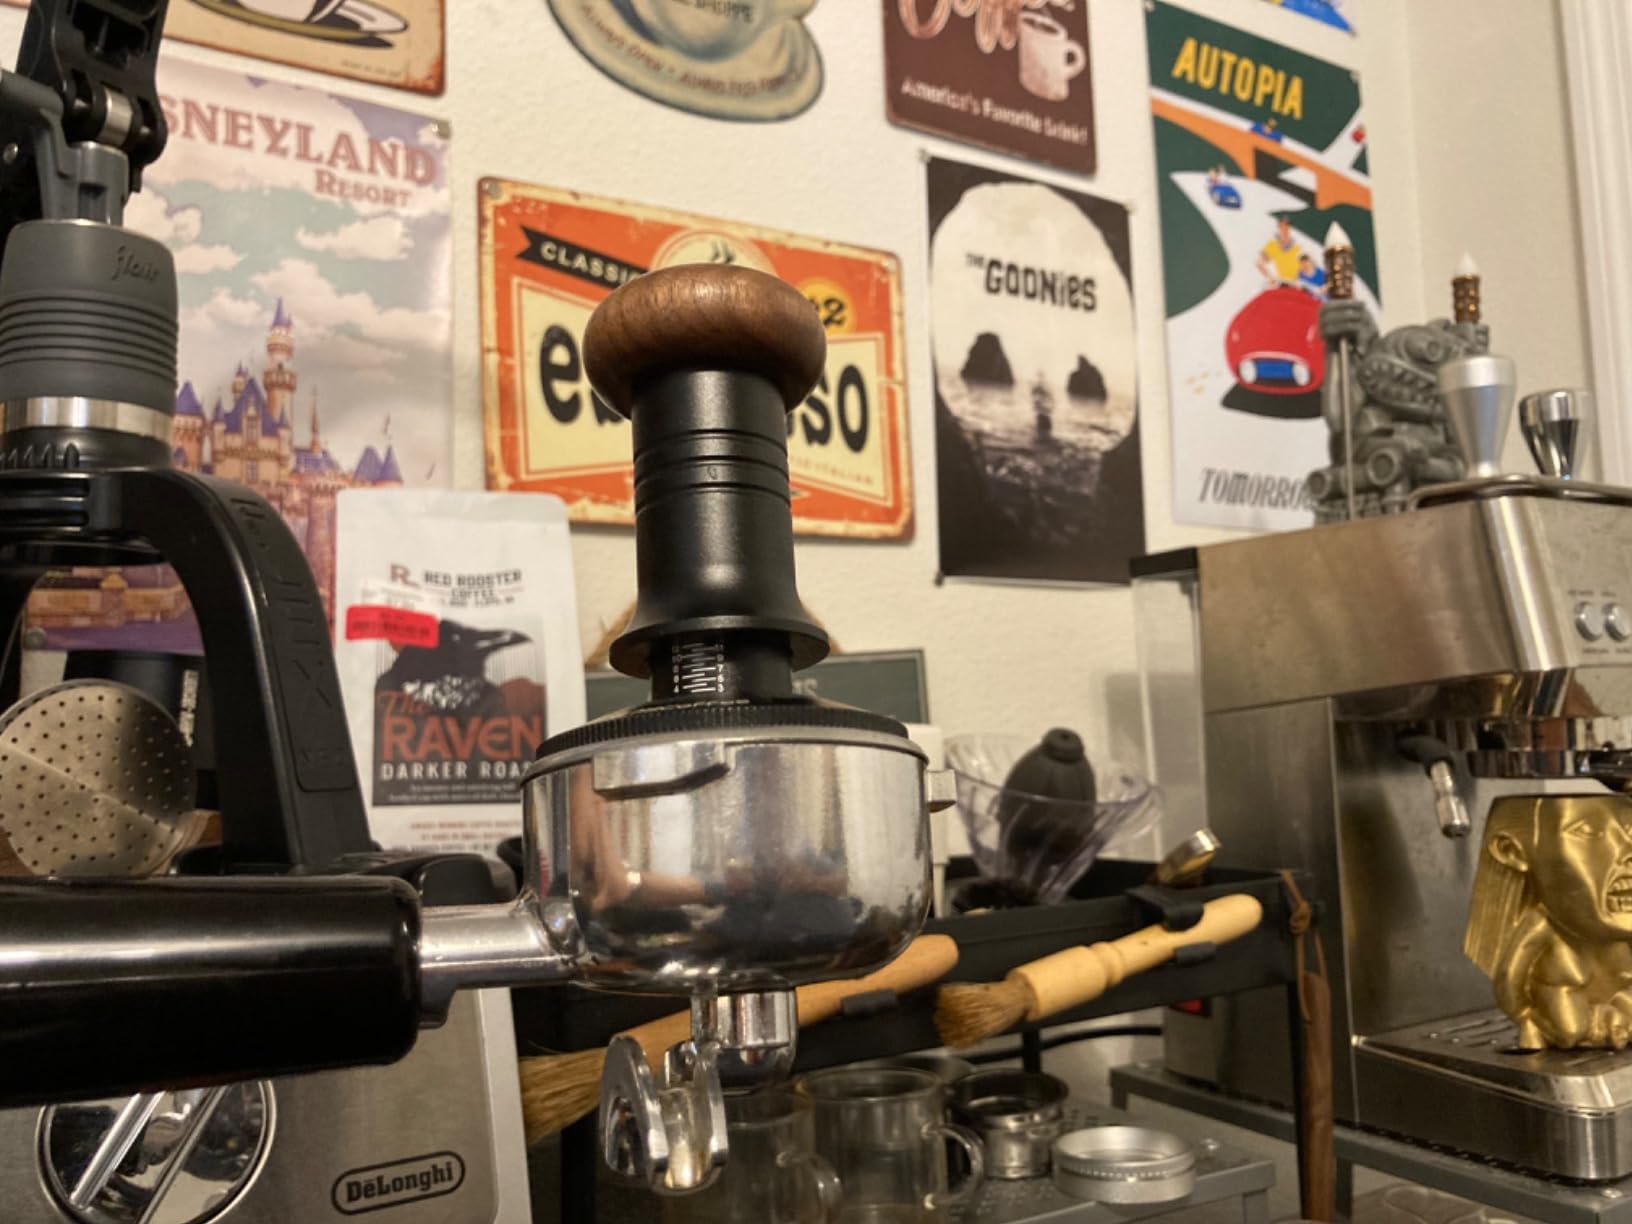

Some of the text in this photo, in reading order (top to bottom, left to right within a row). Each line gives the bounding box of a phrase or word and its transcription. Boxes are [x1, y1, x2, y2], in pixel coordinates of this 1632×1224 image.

[901, 76, 981, 116] America's
[1171, 36, 1304, 121] AUTOPIA
[158, 94, 438, 185] SNEYLAND
[424, 570, 453, 588] RED
[457, 568, 523, 588] ROOSTER
[382, 714, 543, 762] RAVEN
[380, 760, 532, 781] DARKER ROA
